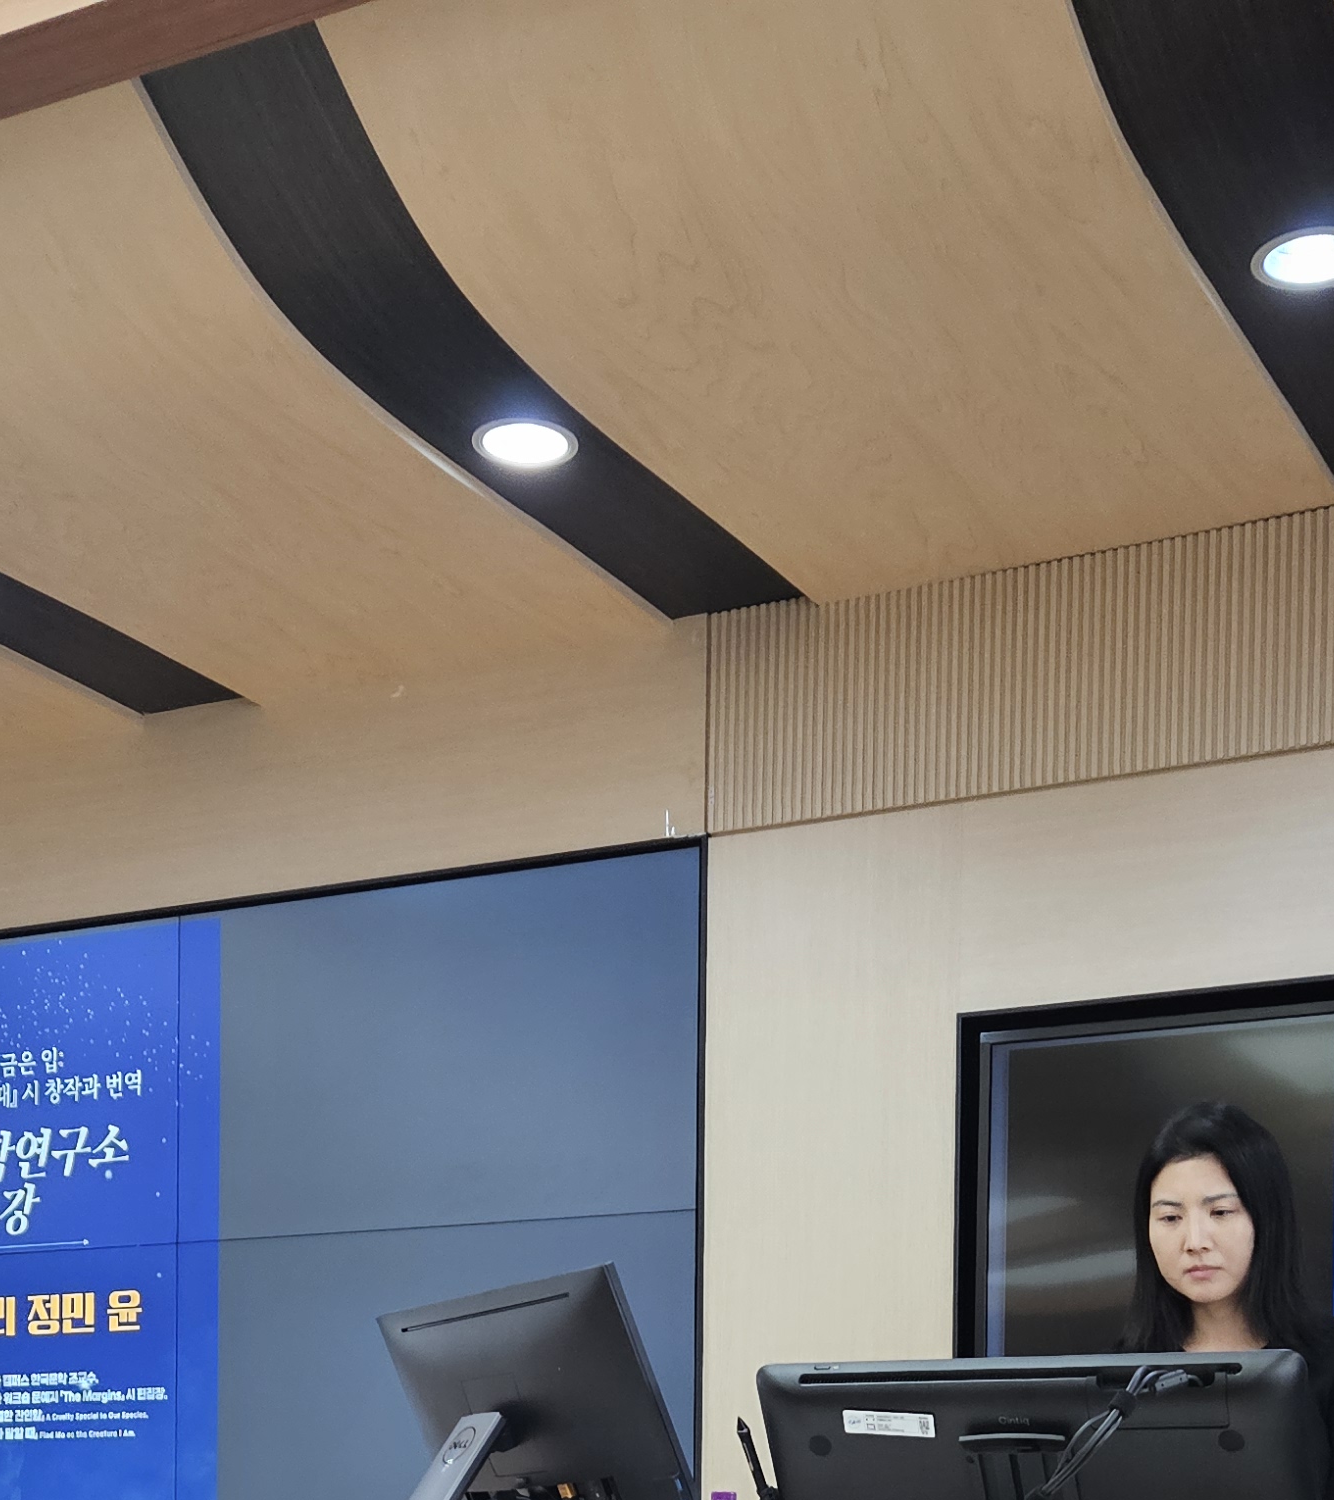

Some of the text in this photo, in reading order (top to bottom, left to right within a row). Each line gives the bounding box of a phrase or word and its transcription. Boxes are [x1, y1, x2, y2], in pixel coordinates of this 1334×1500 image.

[22, 1080, 39, 1105] 시
[45, 1074, 101, 1104] 창작과
[106, 1069, 142, 1099] 번역
[28, 1292, 95, 1335] 정민
[107, 1290, 143, 1332] 윤
